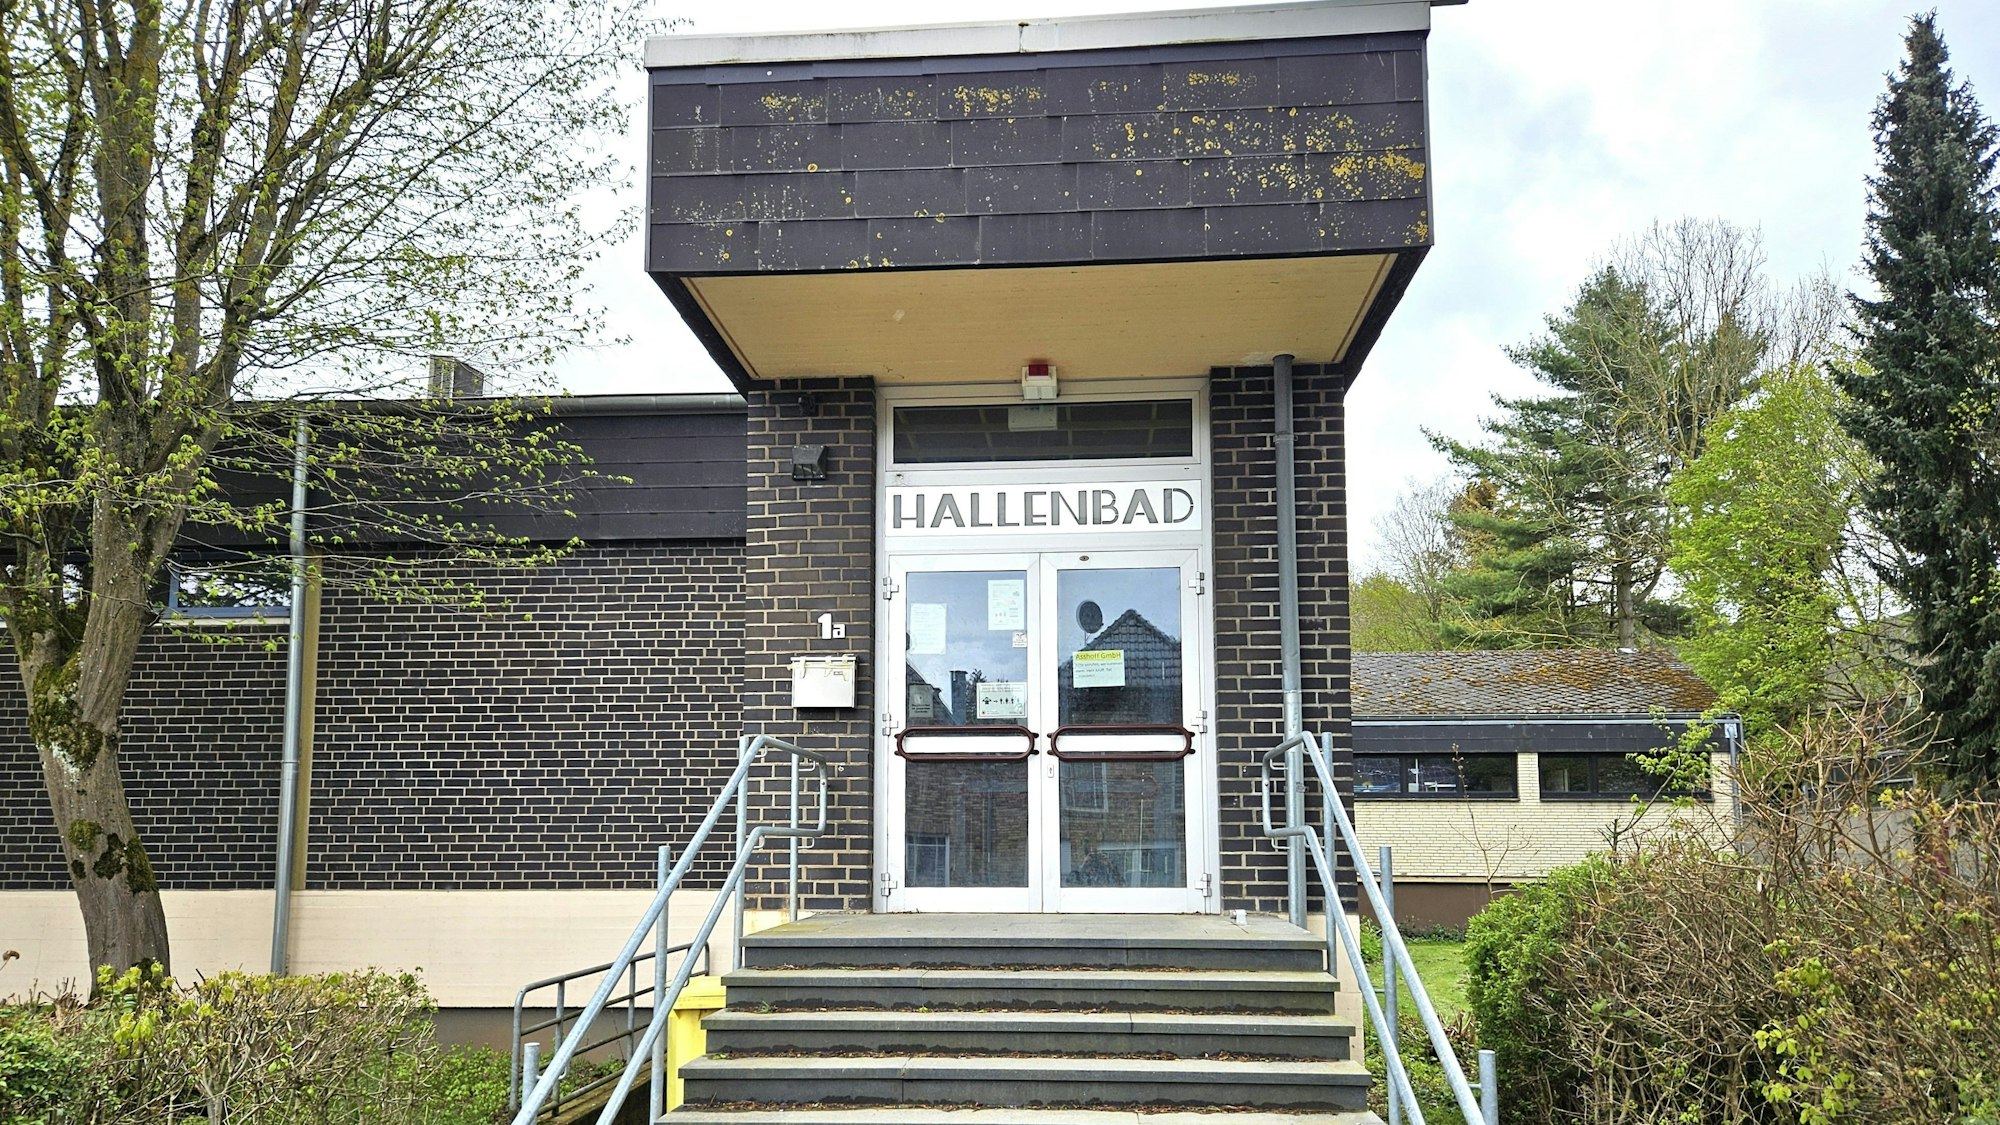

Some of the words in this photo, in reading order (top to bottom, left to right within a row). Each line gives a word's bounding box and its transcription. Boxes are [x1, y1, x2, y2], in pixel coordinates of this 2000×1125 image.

[892, 487, 1194, 529] HALLENBAD
[817, 613, 846, 640] 1a
[1100, 651, 1121, 659] GmbH
